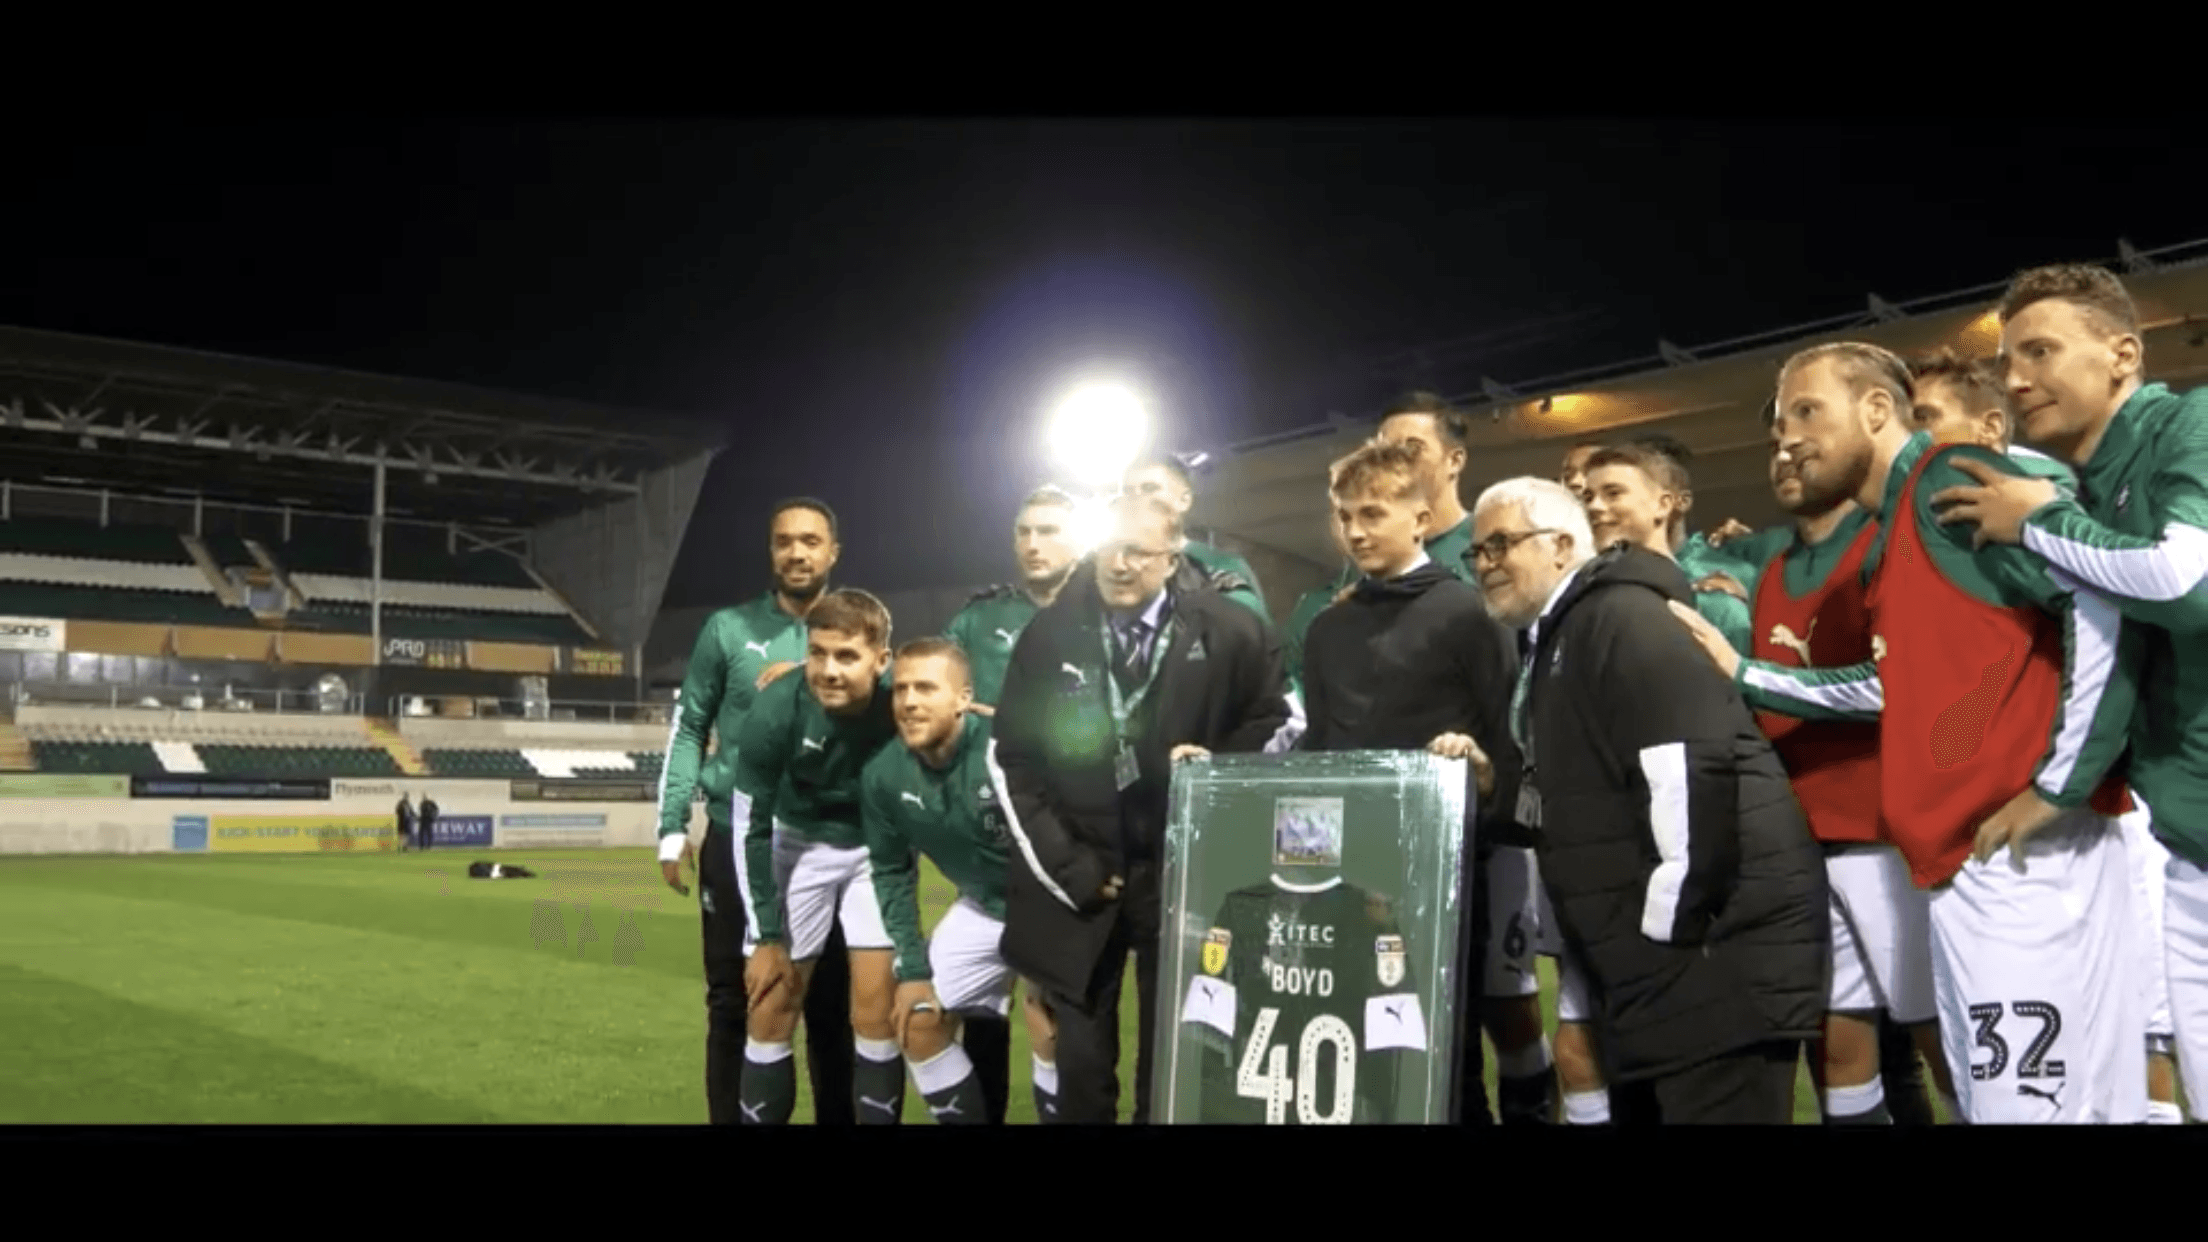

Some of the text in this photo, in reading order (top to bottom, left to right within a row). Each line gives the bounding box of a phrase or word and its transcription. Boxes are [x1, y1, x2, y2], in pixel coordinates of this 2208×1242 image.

[1287, 924, 1335, 943] ITEC
[1503, 910, 1527, 959] 6
[1271, 963, 1334, 997] BOYD
[1968, 1000, 2065, 1080] 32
[1237, 1007, 1356, 1124] 40
